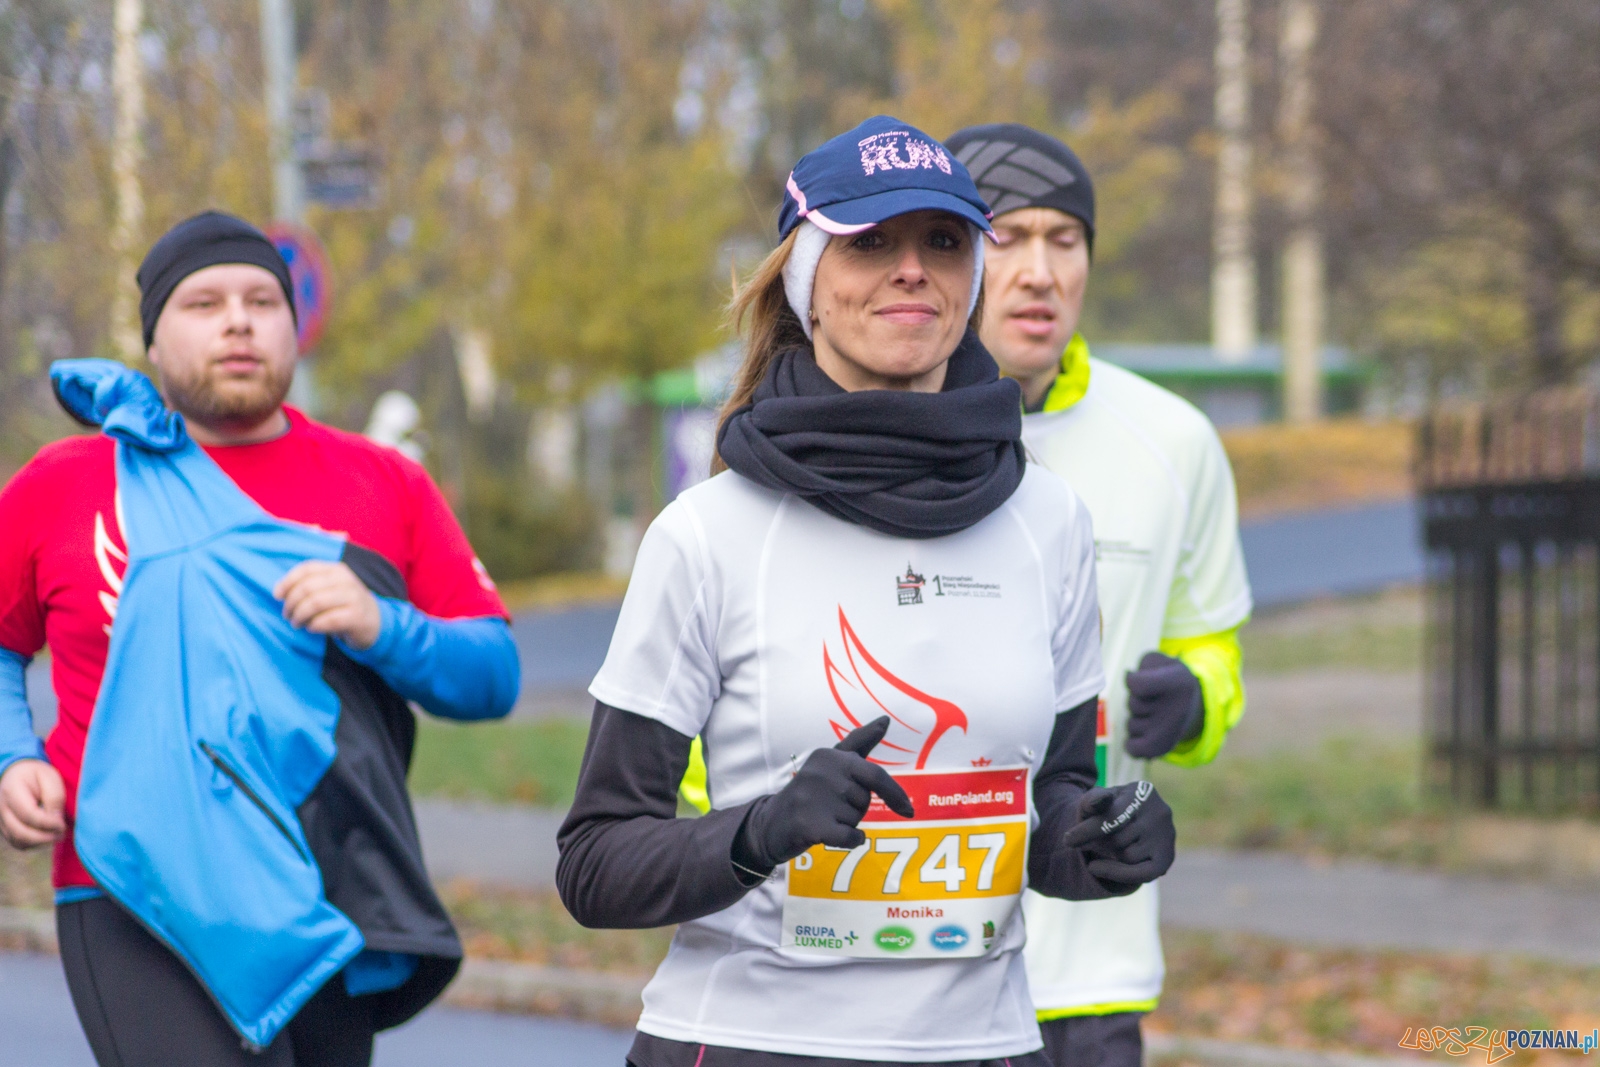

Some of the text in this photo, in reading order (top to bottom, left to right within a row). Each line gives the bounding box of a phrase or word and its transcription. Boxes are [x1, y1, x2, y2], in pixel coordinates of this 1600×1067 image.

[861, 142, 952, 176] RUN
[932, 574, 945, 596] 1
[928, 790, 1014, 806] RunPoland.org
[824, 832, 1006, 894] 7747
[886, 906, 944, 919] Monika
[795, 925, 836, 938] GRUPA
[795, 936, 843, 949] LUXMED
